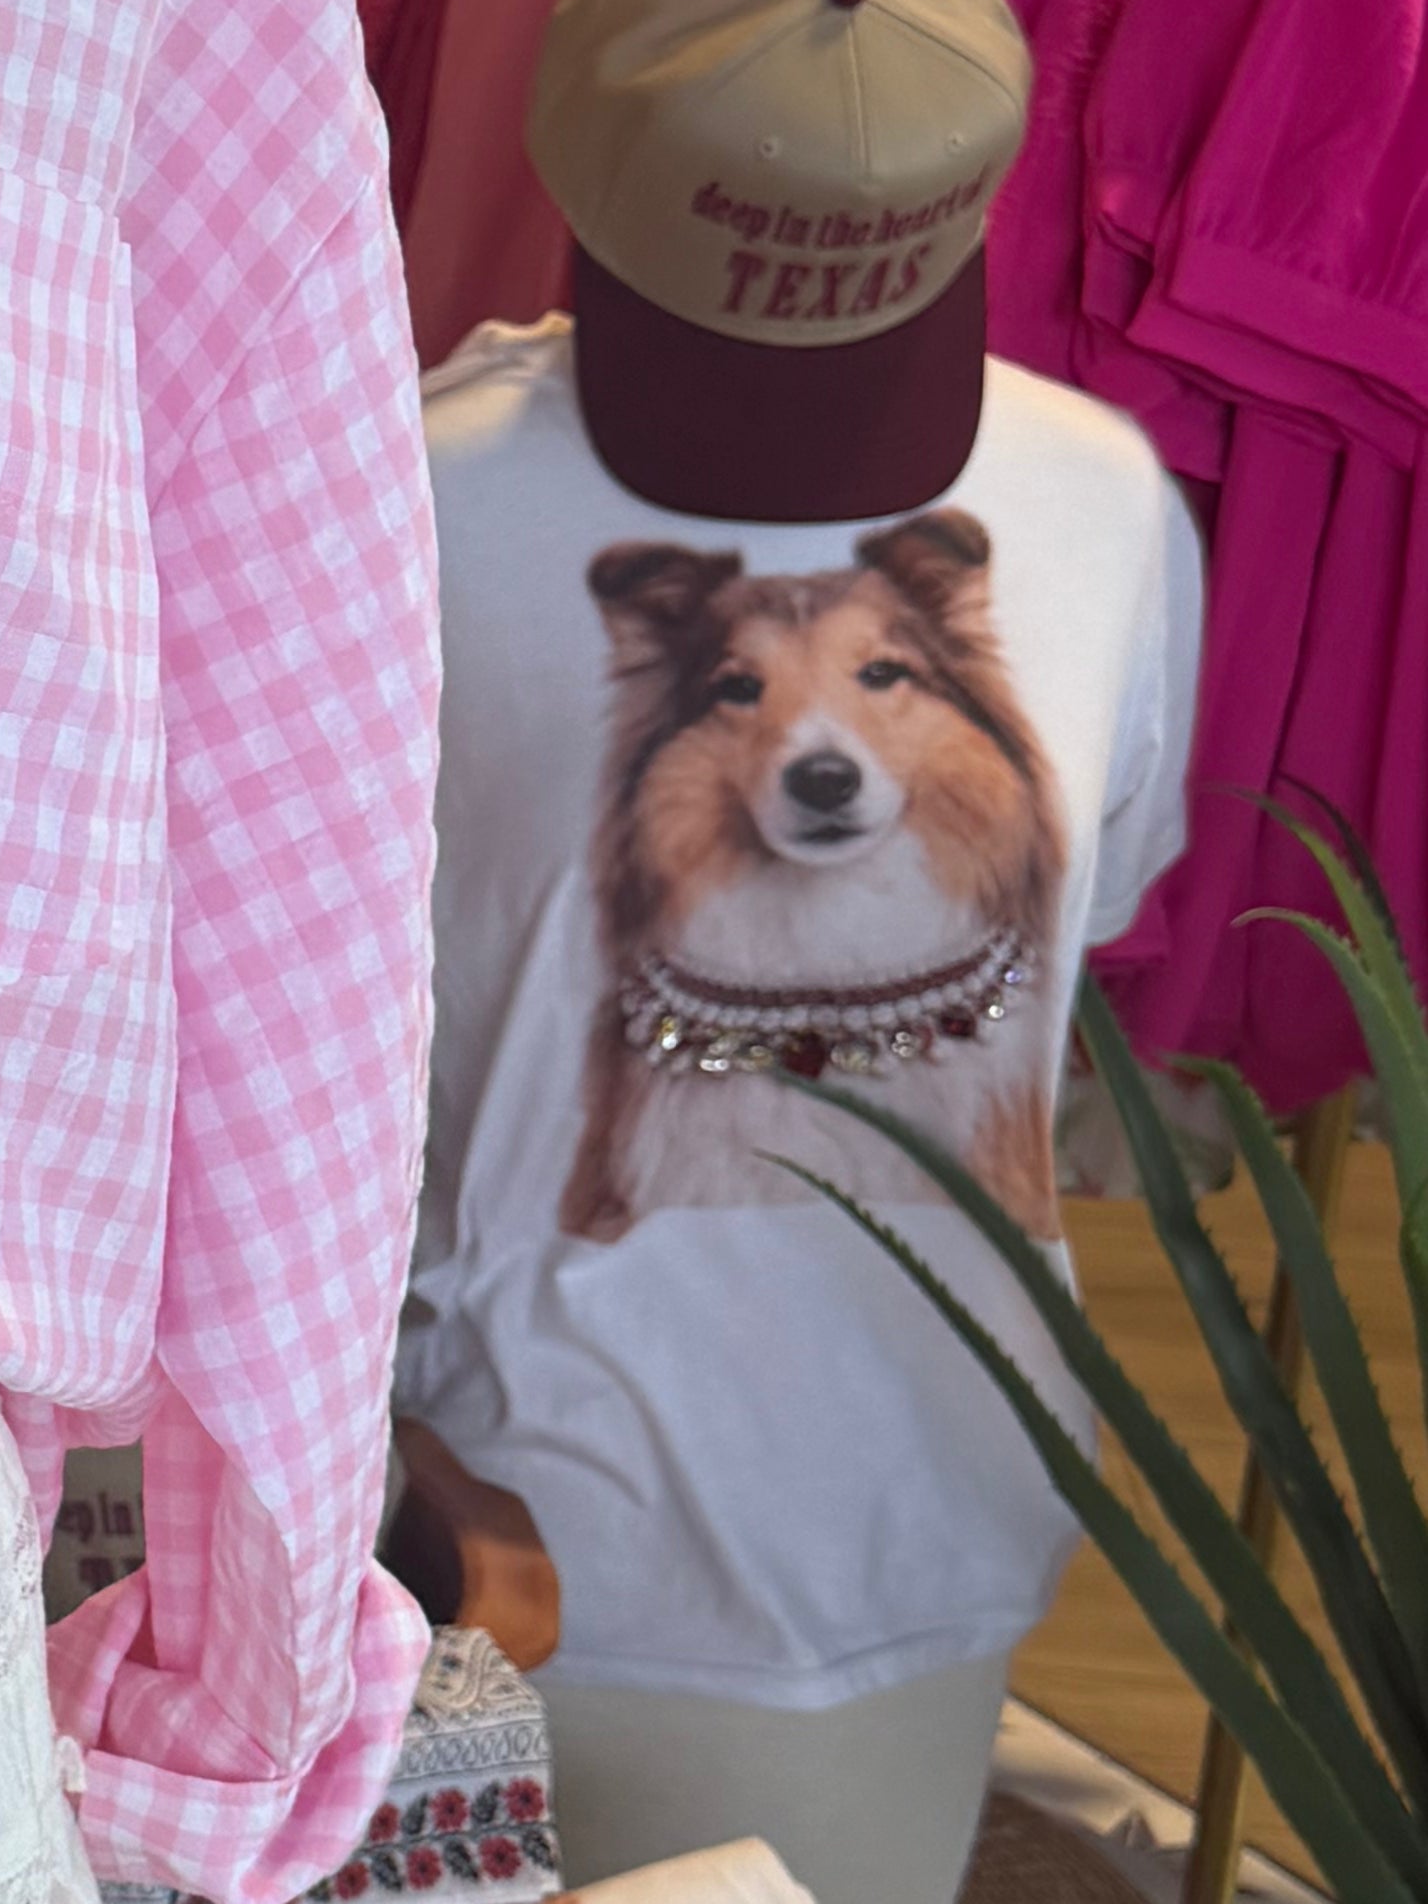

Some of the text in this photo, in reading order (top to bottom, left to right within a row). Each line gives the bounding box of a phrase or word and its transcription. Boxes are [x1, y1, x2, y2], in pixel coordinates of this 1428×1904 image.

[691, 181, 770, 242] deep
[773, 206, 811, 246] in
[815, 210, 872, 247] the
[721, 242, 931, 319] TEXAS
